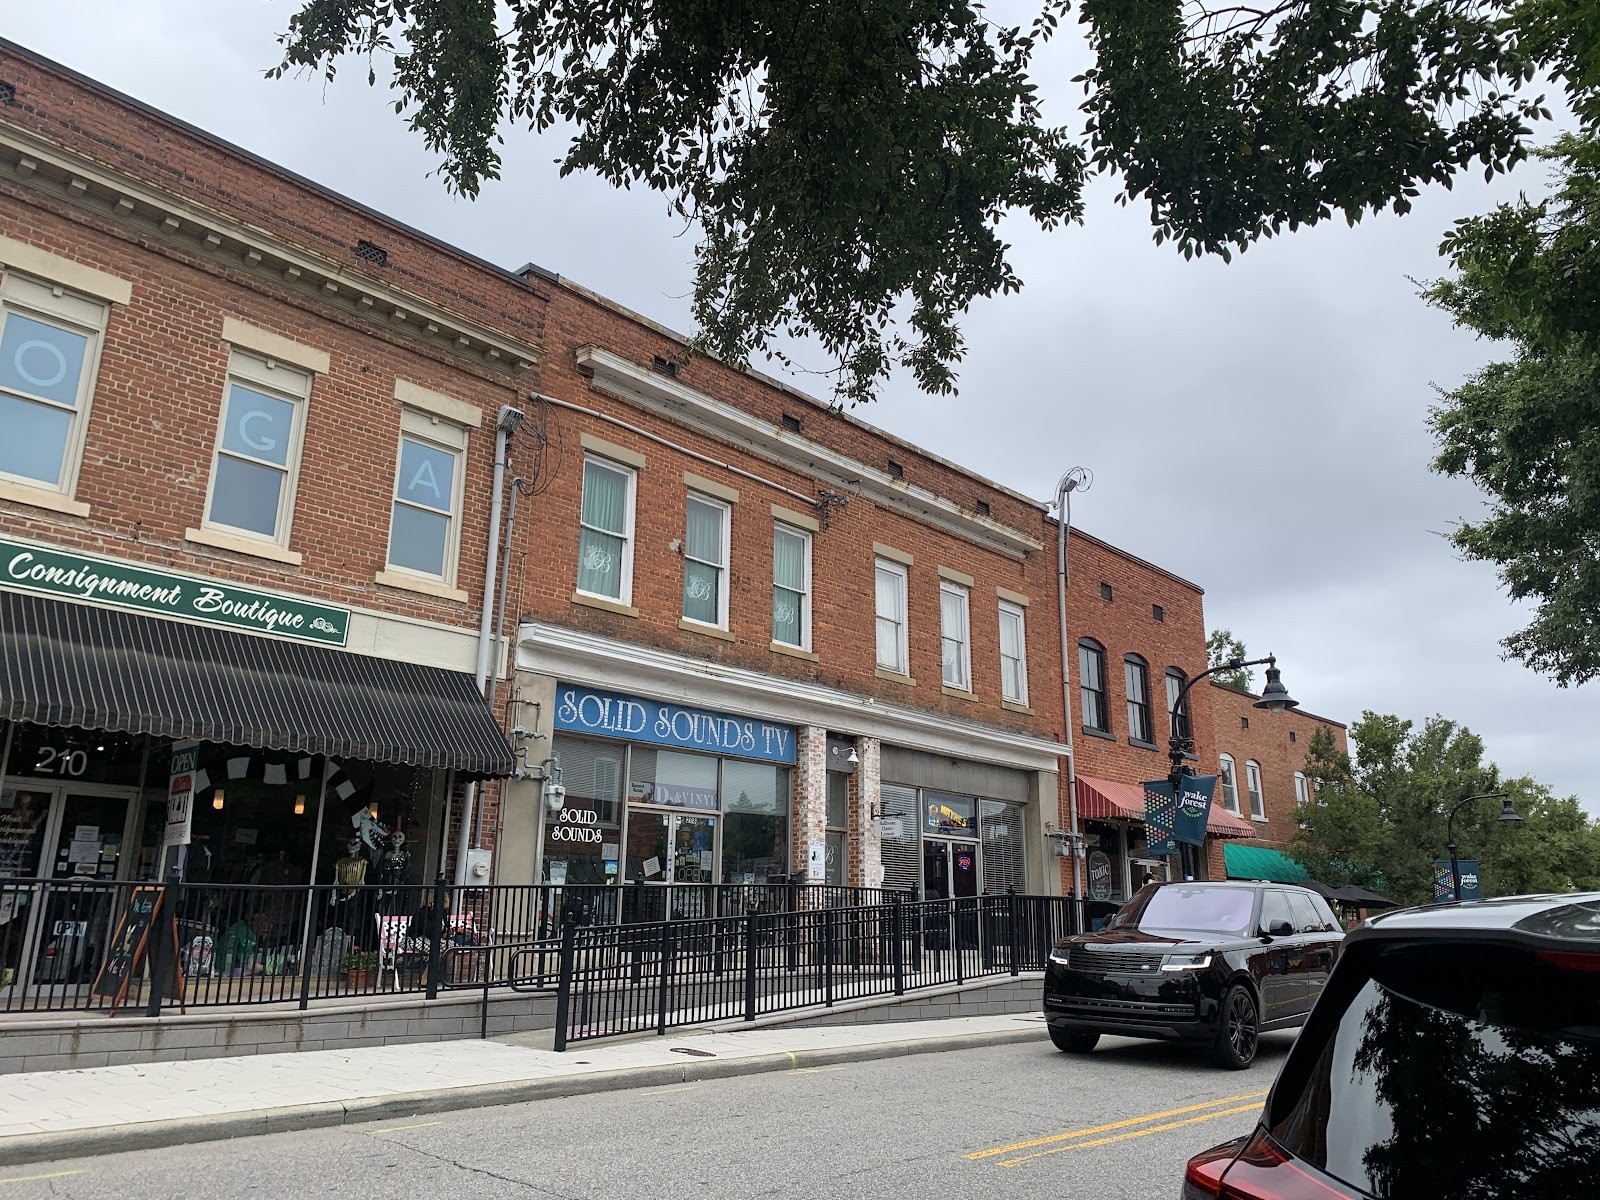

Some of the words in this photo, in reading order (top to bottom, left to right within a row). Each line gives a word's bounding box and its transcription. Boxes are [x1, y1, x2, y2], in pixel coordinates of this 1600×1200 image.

[239, 410, 276, 451] G
[407, 459, 441, 499] A
[8, 551, 182, 607] Consignment
[193, 586, 305, 631] Boutique
[558, 690, 647, 734] SOLID
[654, 706, 755, 751] SOUNDS
[761, 723, 789, 757] TV
[33, 746, 87, 776] 210
[171, 751, 197, 774] OPEN
[1177, 796, 1207, 810] forest
[1184, 790, 1208, 802] wake
[559, 807, 597, 825] SOLID
[552, 825, 602, 843] SOUNDS
[678, 868, 708, 883] OPEN
